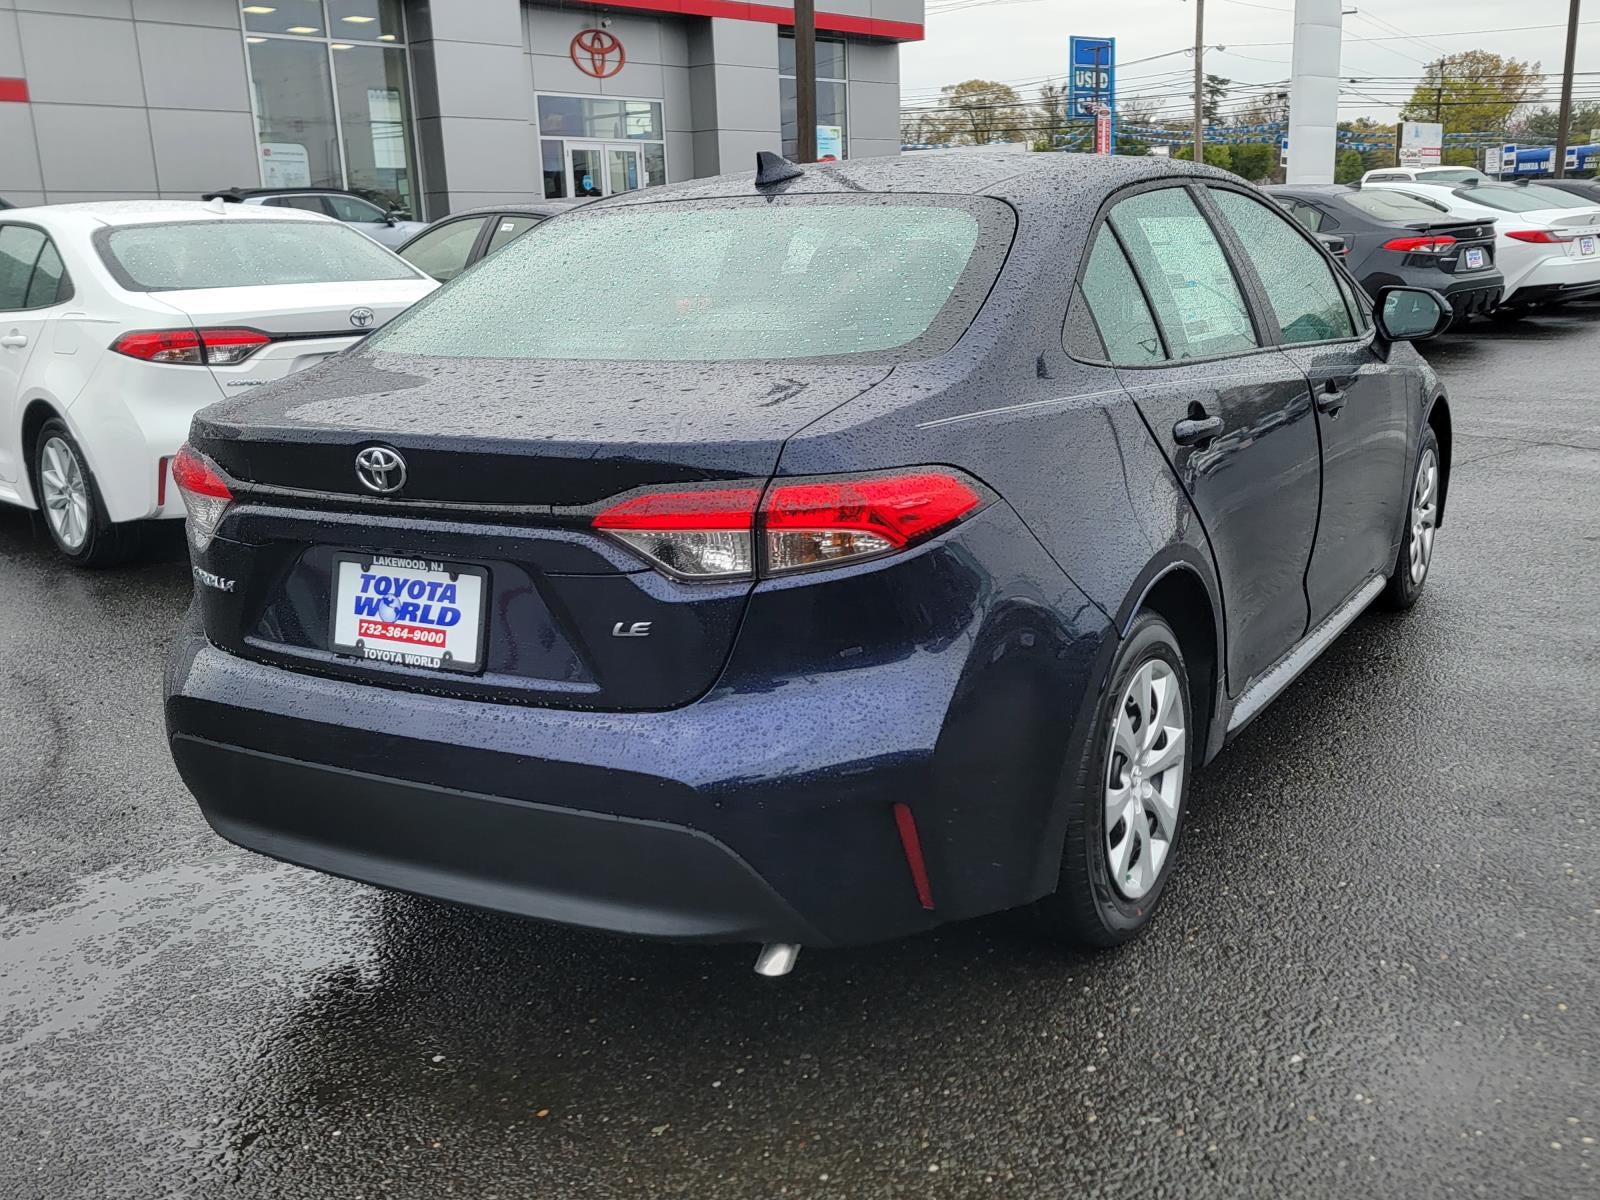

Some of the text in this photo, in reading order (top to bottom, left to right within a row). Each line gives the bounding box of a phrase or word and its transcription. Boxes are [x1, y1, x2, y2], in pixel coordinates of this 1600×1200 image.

[373, 555, 444, 572] LAKEWOOD, NJ
[360, 573, 457, 605] TOYOTA
[354, 595, 462, 627] WORLD
[360, 623, 445, 644] 732-364-9000
[612, 622, 653, 636] LE
[363, 648, 441, 669] TOYOTA WORLD
